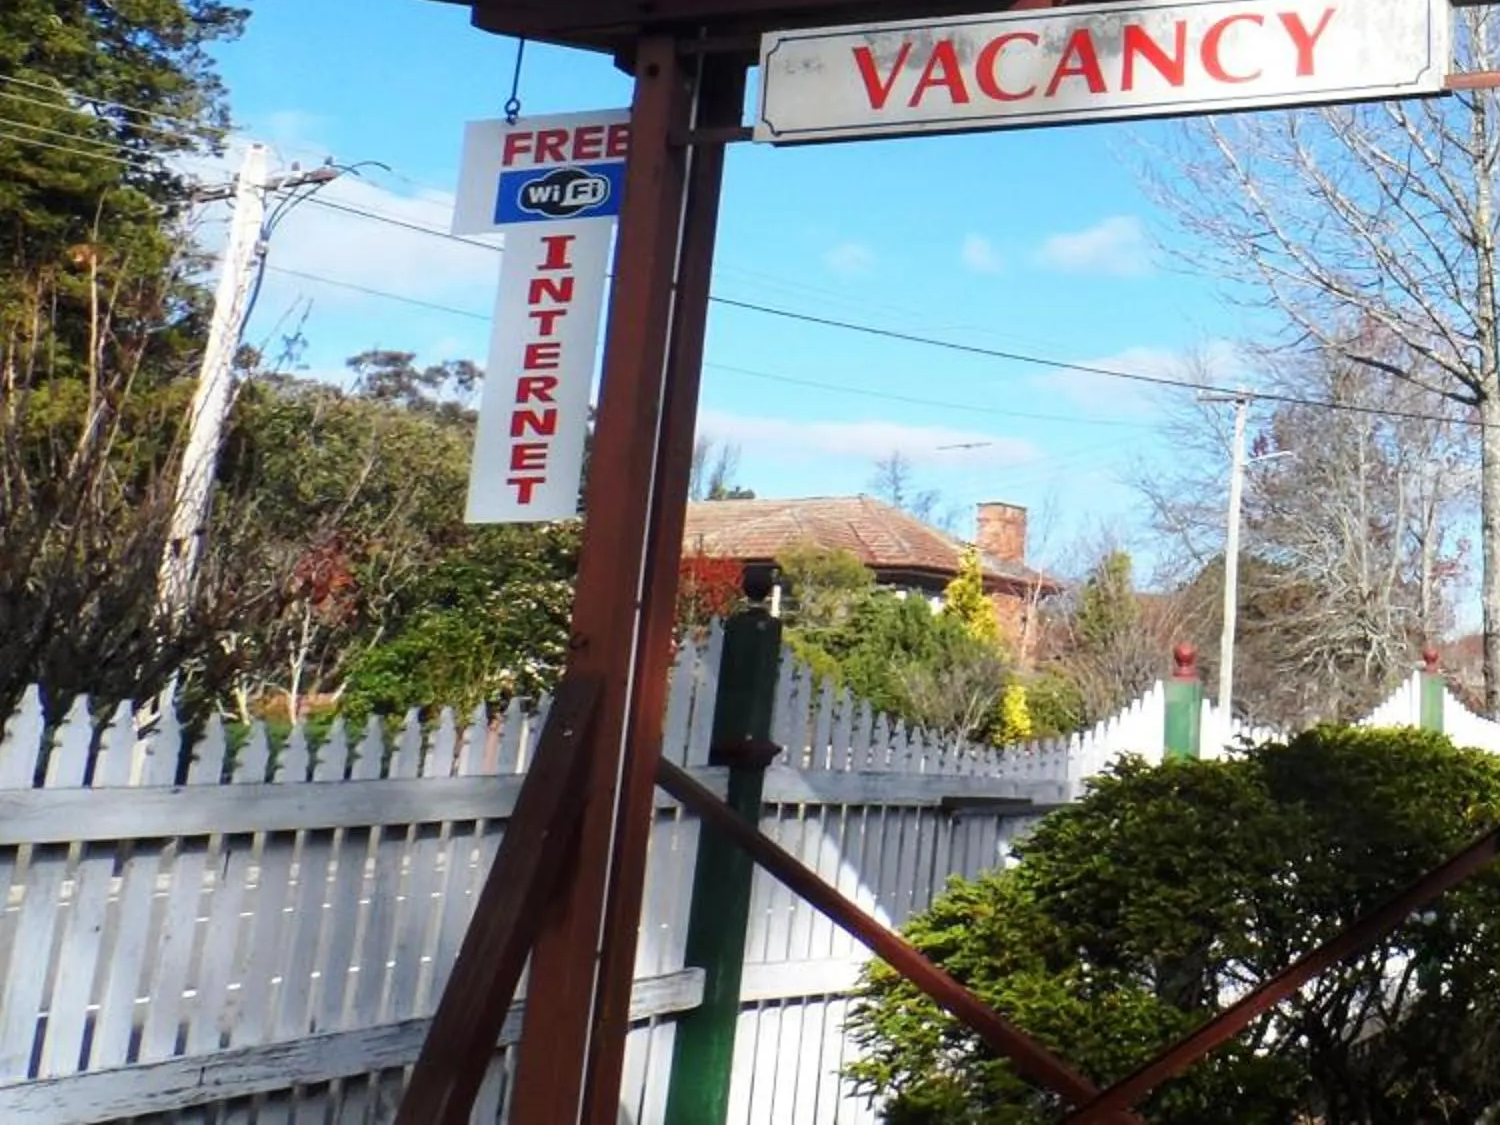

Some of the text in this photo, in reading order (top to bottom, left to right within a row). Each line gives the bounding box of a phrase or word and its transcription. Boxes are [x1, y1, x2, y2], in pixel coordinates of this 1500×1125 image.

[851, 8, 1336, 110] VACANCY
[502, 124, 630, 166] FREE
[507, 235, 576, 504] INTERNET
